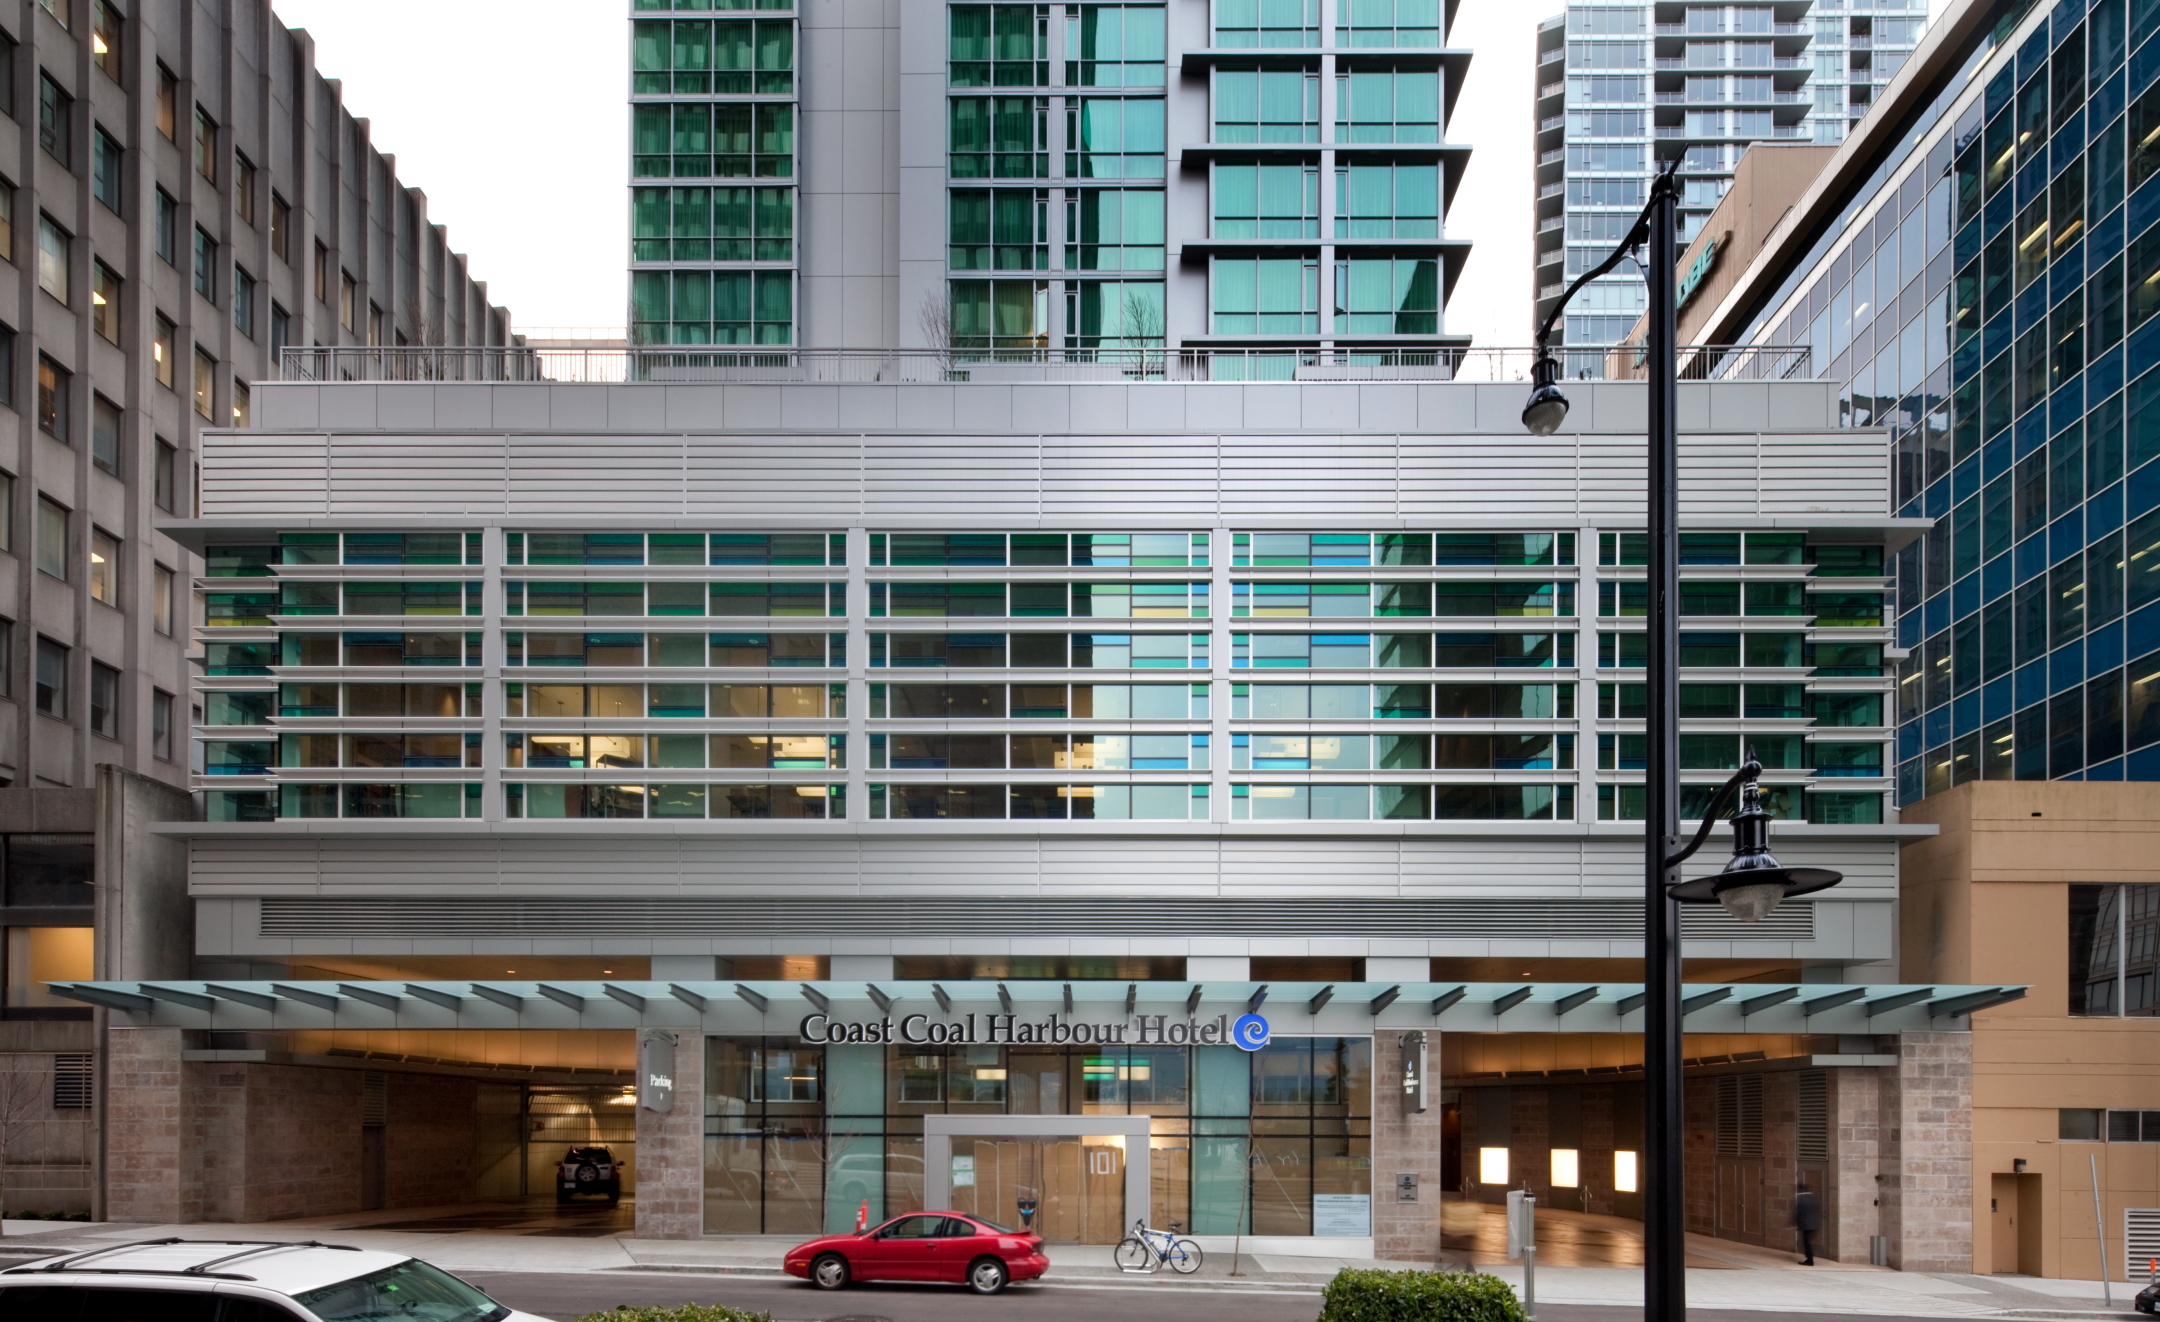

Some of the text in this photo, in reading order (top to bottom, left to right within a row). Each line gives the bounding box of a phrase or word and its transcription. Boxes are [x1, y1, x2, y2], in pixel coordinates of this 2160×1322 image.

[800, 1013, 1229, 1044] Coast Coal Harbour Hotel
[650, 1073, 673, 1091] Parking
[1090, 1151, 1116, 1175] 101
